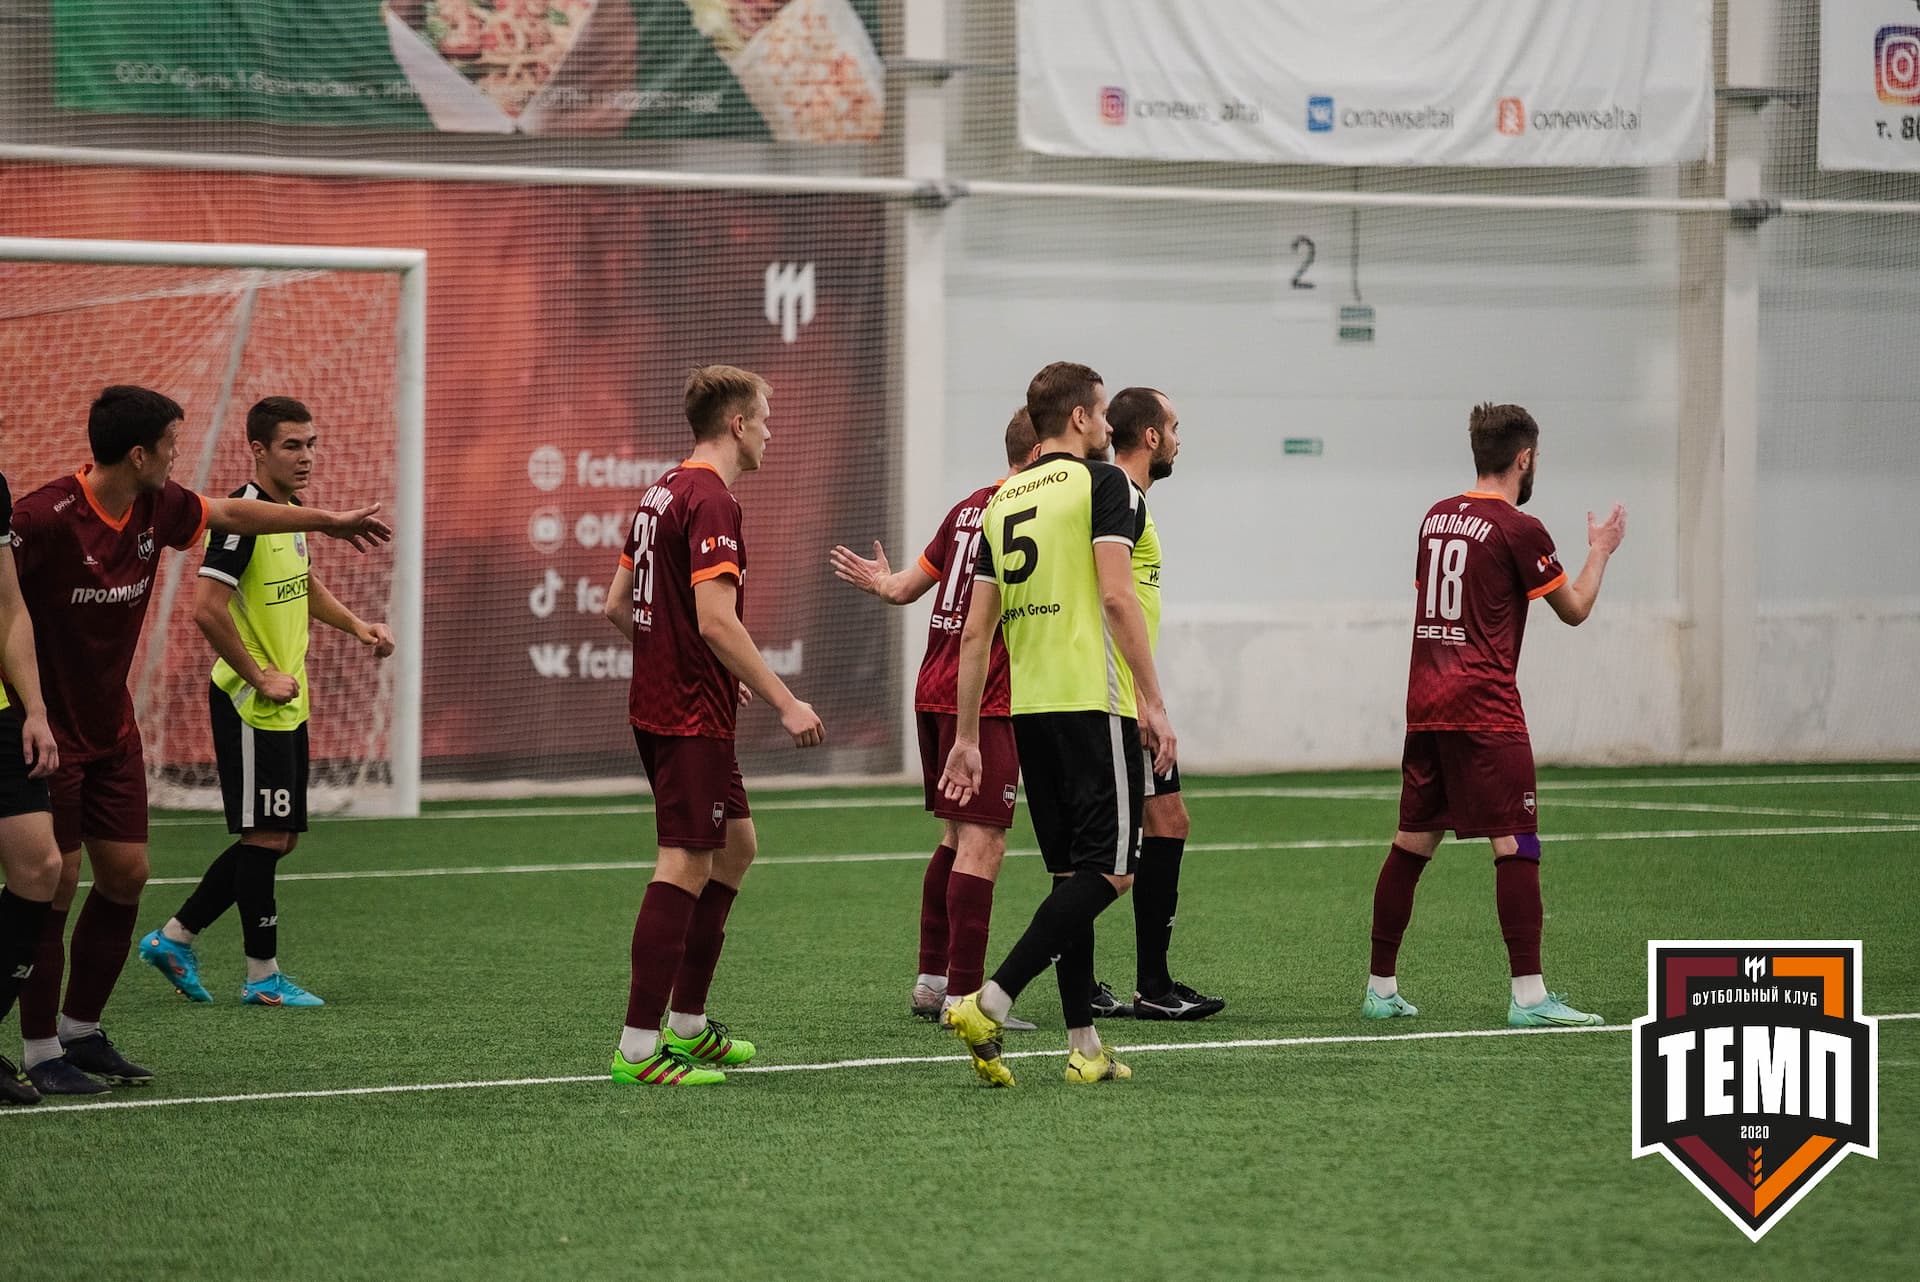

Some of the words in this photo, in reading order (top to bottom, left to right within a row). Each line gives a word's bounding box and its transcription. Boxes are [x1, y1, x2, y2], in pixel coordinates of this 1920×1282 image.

[1901, 114, 1920, 142] 8
[1290, 234, 1317, 291] 2
[1421, 513, 1494, 543] АПАЛЬКИН
[1002, 505, 1039, 585] 5
[1425, 537, 1469, 621] 18
[1416, 624, 1467, 641] SELS
[259, 788, 292, 818] 18
